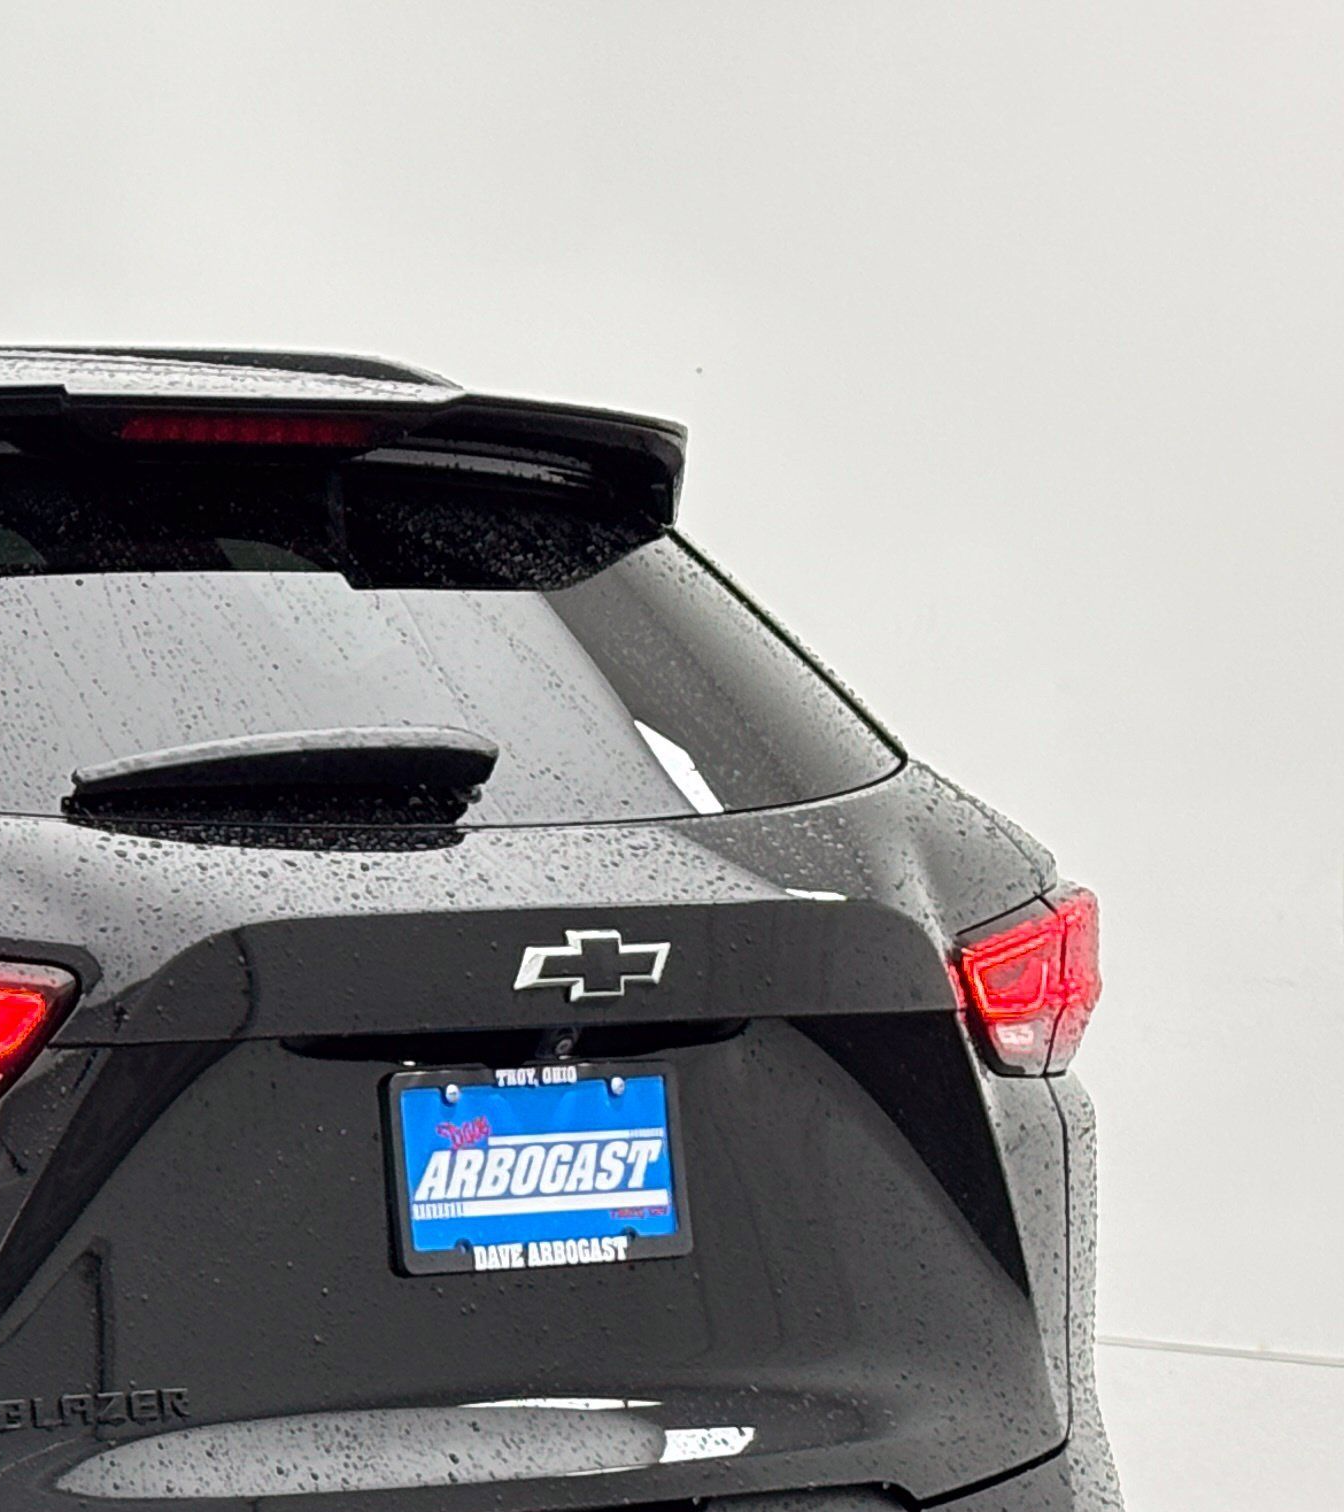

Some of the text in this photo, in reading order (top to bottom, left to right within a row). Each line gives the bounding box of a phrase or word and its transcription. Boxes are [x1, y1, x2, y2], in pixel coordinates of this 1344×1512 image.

[496, 1065, 578, 1088] TROY, OHIO
[414, 1138, 662, 1201] ARBOGAST
[473, 1235, 629, 1271] DAVE ARBOGAST
